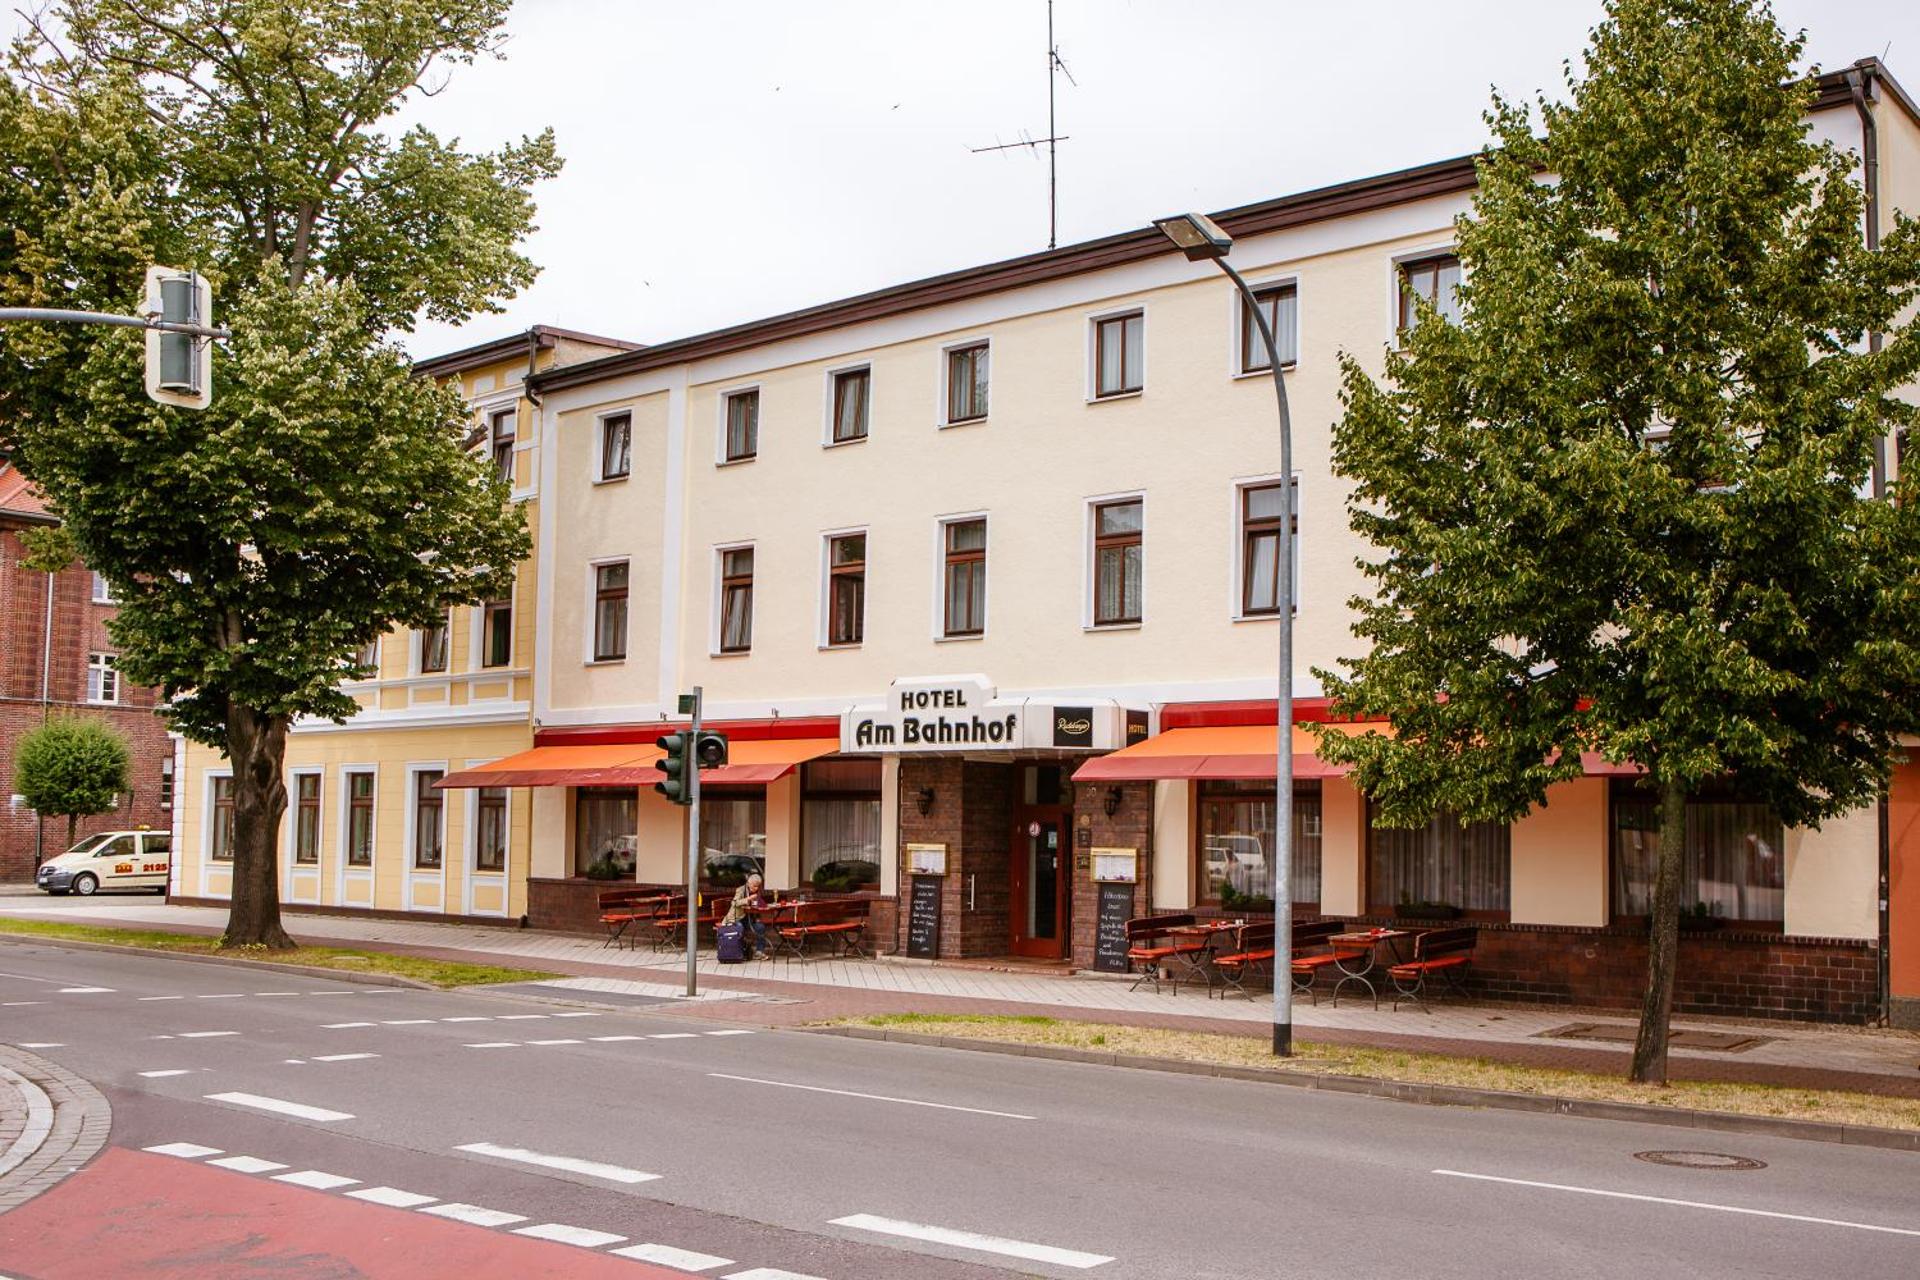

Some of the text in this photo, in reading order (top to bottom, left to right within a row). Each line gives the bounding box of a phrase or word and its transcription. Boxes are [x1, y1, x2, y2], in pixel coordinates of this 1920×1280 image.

[901, 689, 967, 712] HOTEL
[856, 713, 1017, 748] Am Bahnhof
[1128, 724, 1147, 734] HOTEL
